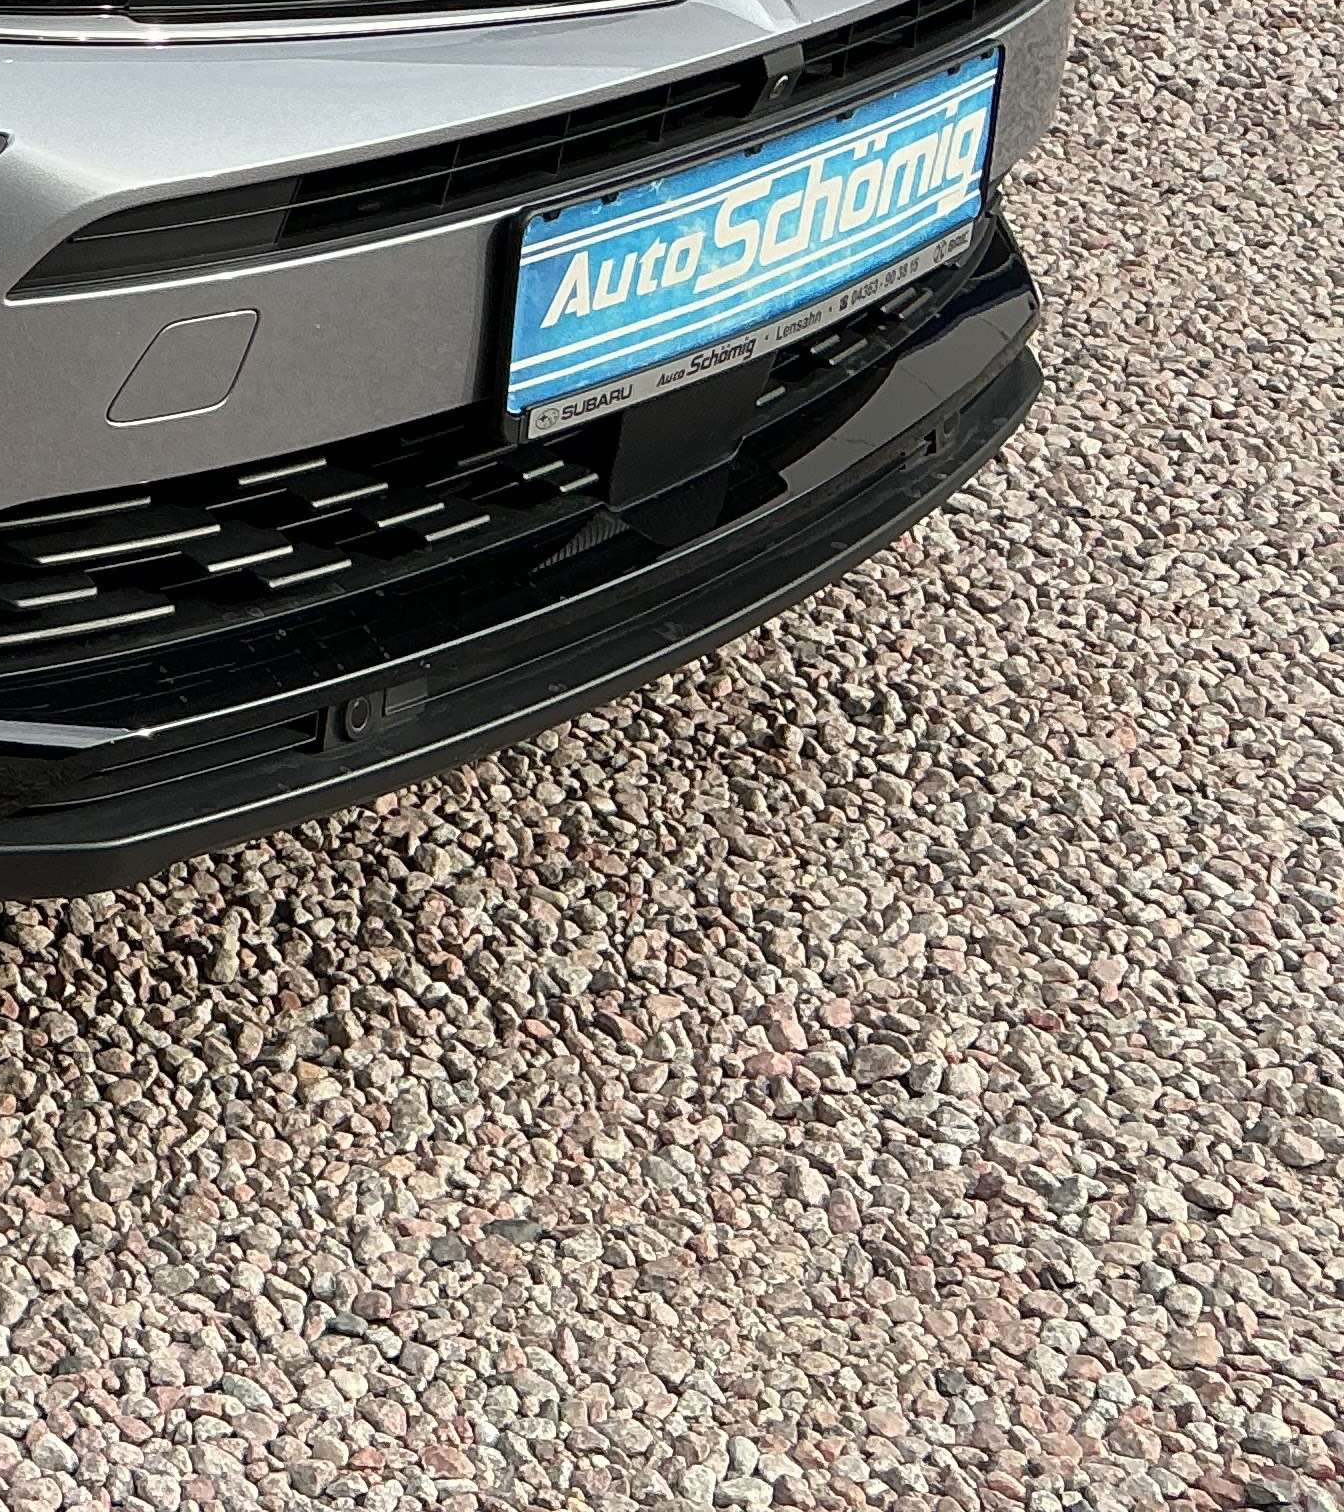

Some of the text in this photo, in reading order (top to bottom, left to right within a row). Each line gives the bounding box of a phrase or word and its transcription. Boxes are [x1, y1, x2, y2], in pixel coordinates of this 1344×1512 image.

[540, 101, 988, 328] Auto Schömig
[656, 370, 686, 388] Auto
[686, 336, 757, 377] Schömig
[561, 384, 634, 420] SUBARU
